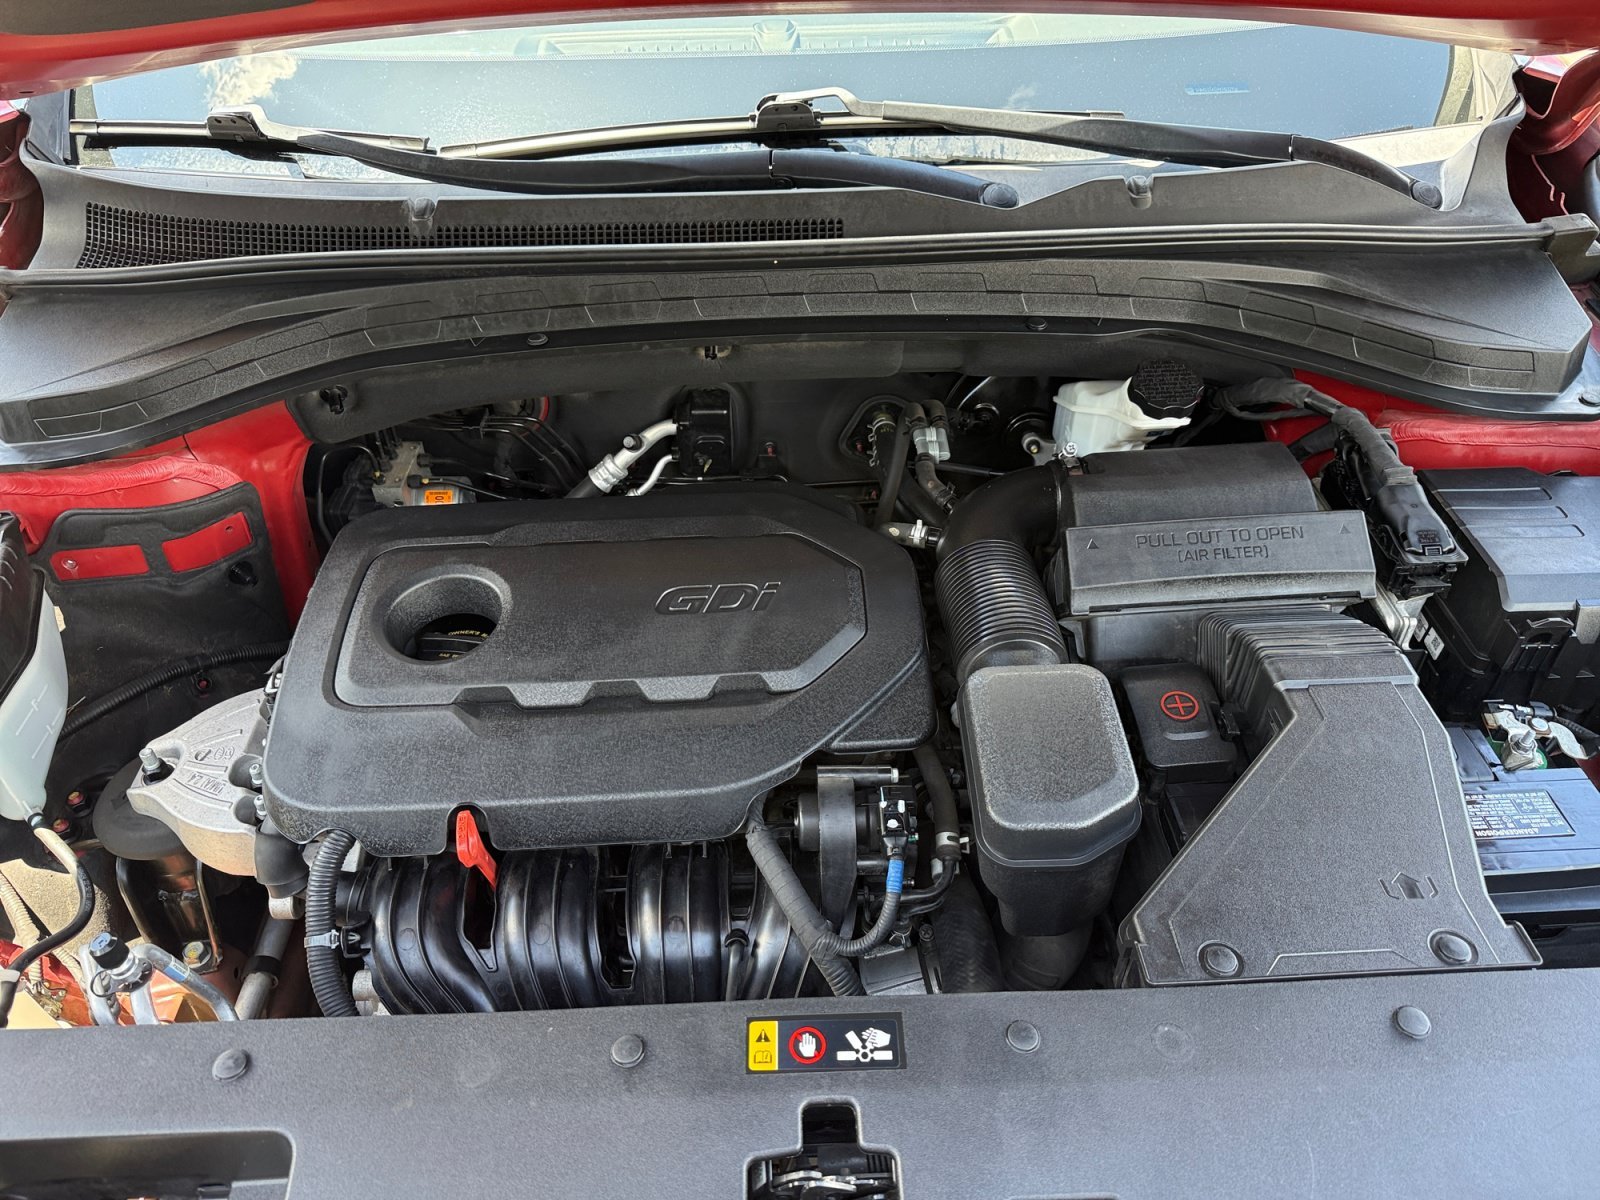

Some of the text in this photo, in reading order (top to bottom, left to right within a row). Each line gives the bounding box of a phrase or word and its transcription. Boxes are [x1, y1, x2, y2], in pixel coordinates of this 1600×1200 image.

[1135, 525, 1304, 549] PULL OUT TO OPEN
[655, 581, 781, 615] GDi
